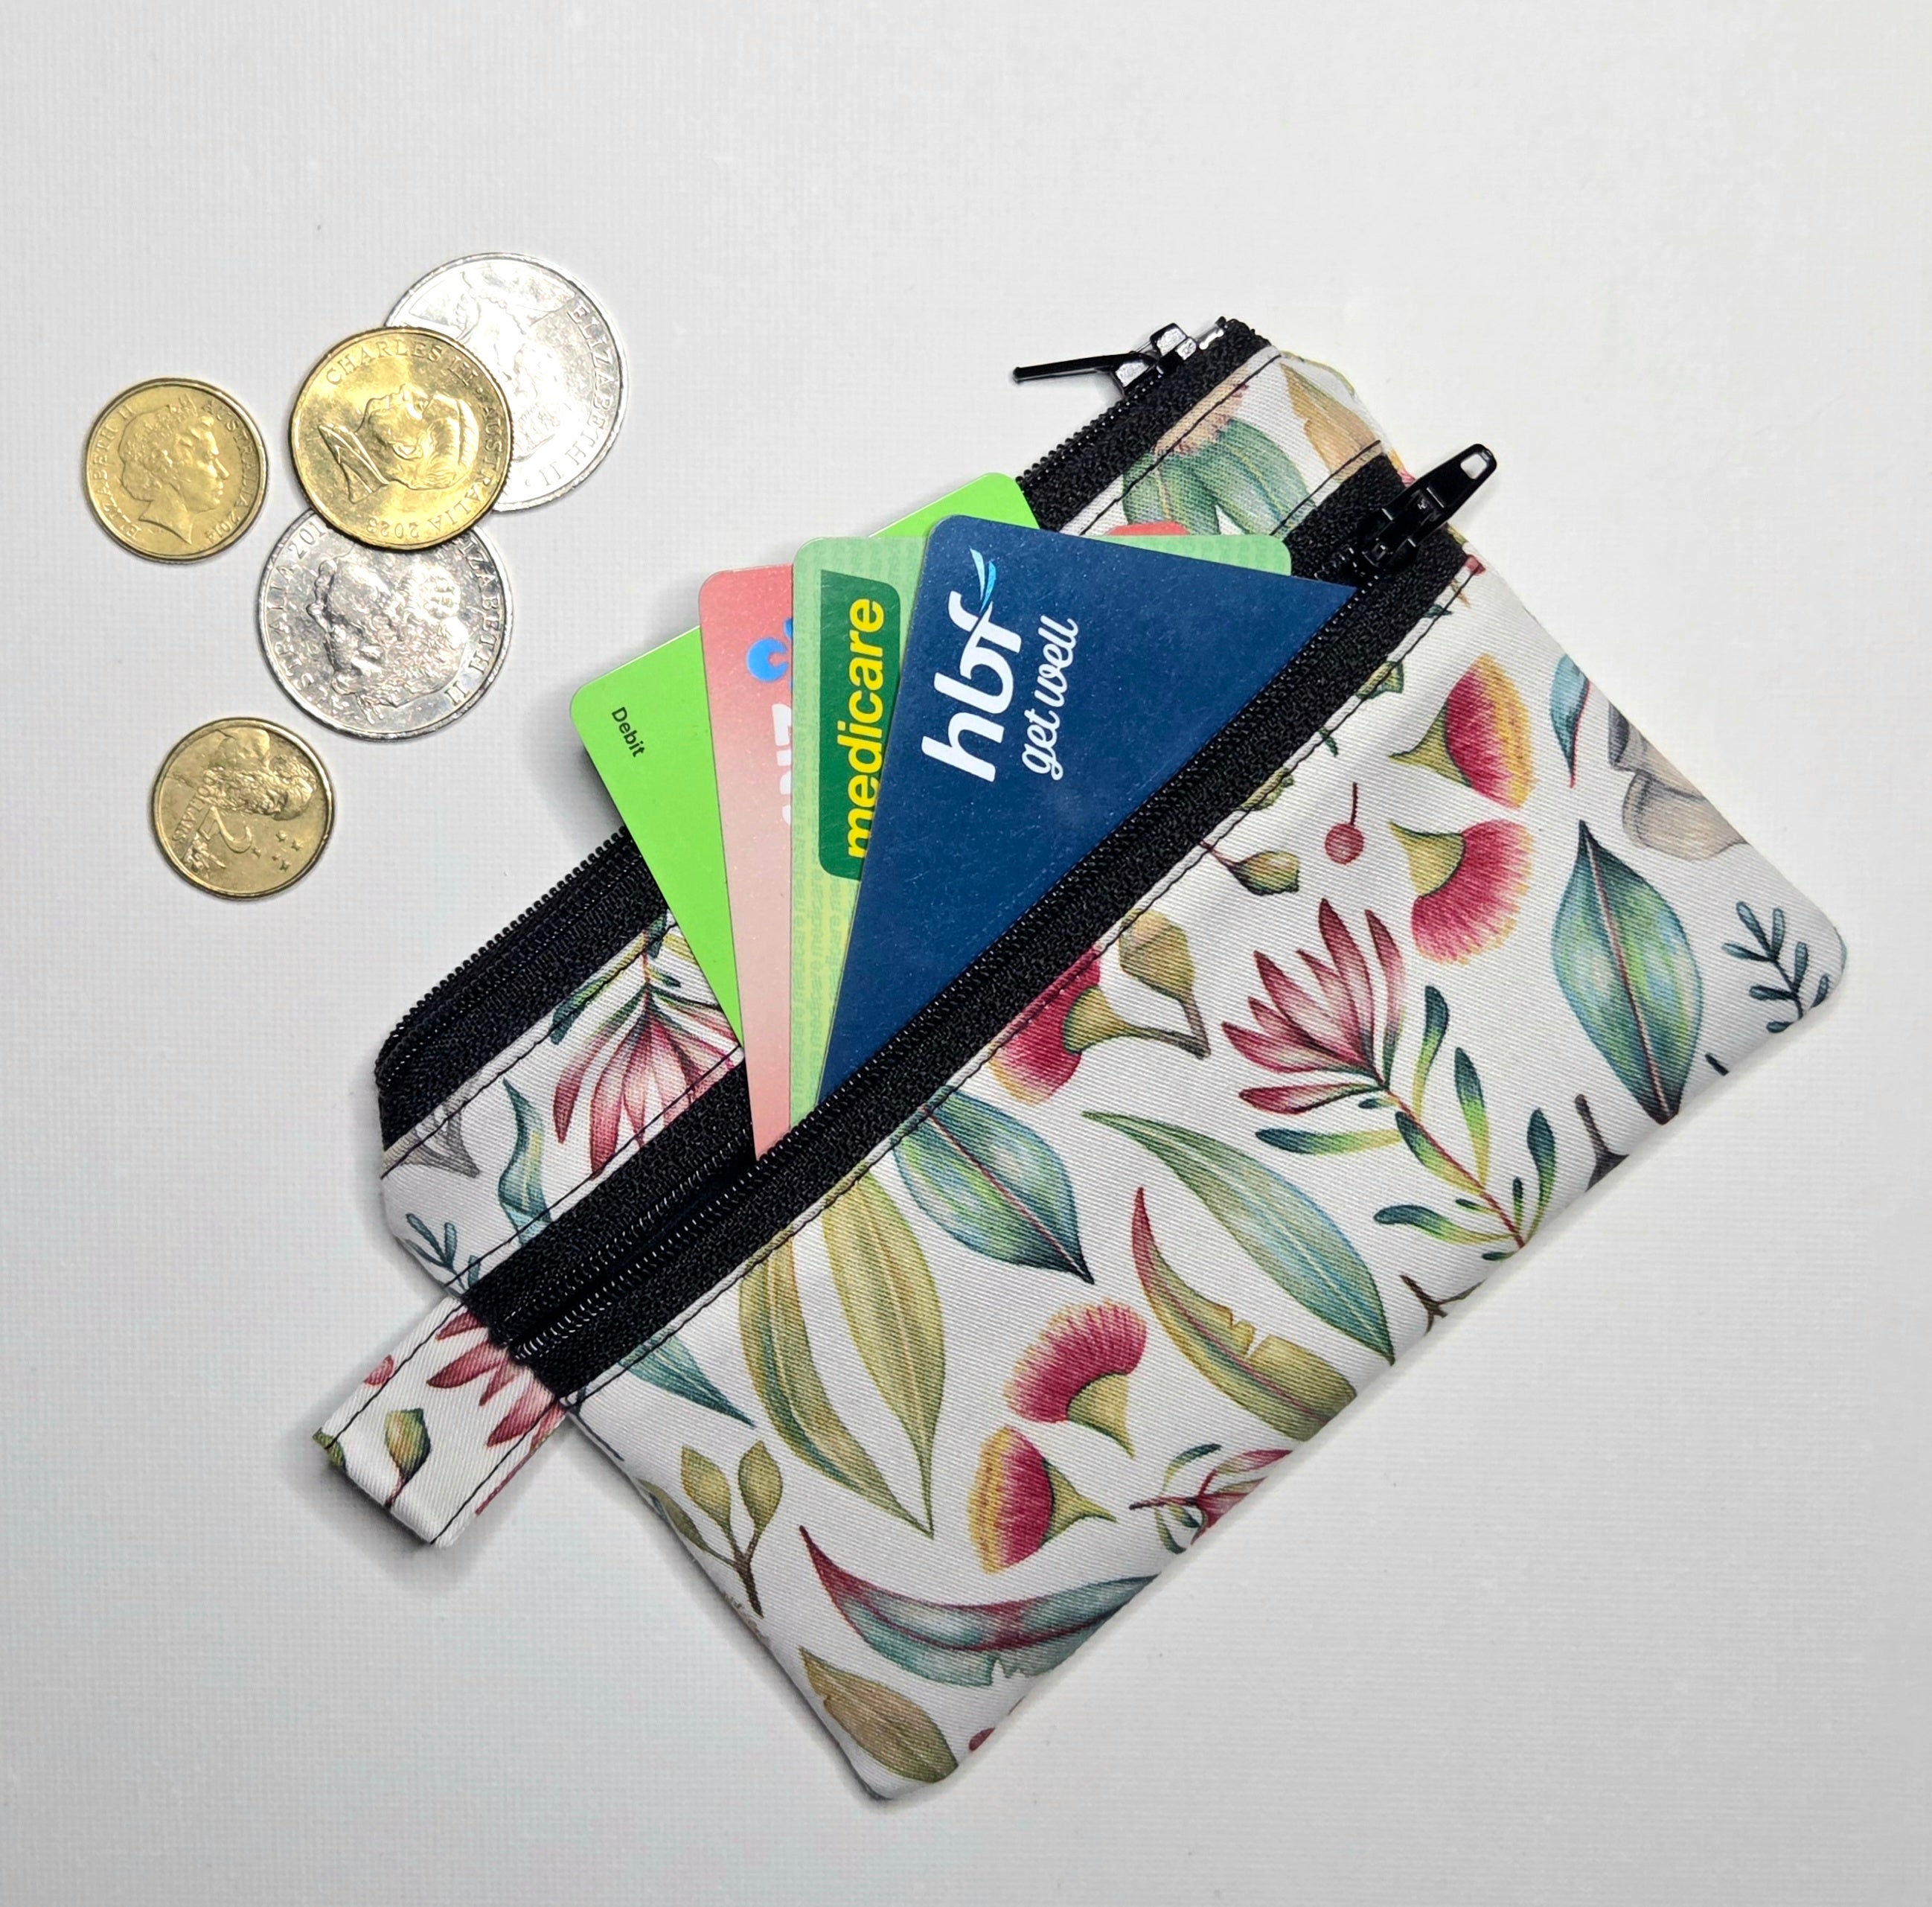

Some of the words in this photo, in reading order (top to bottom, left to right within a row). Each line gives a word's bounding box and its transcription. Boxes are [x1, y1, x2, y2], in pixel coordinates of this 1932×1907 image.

[326, 339, 443, 385] CHARLES
[447, 355, 481, 387] III
[564, 303, 615, 466] ELIZABETH
[93, 424, 142, 540] ELIZABETH
[202, 400, 257, 509] AUSTRALIA
[428, 406, 505, 533] AUSTRALIA
[287, 521, 327, 560] 201
[459, 536, 501, 675] IZABETH
[921, 590, 1023, 782] hbf
[1034, 615, 1078, 707] well
[612, 707, 644, 758] Debit
[837, 598, 885, 858] medicare
[1022, 708, 1063, 781] get
